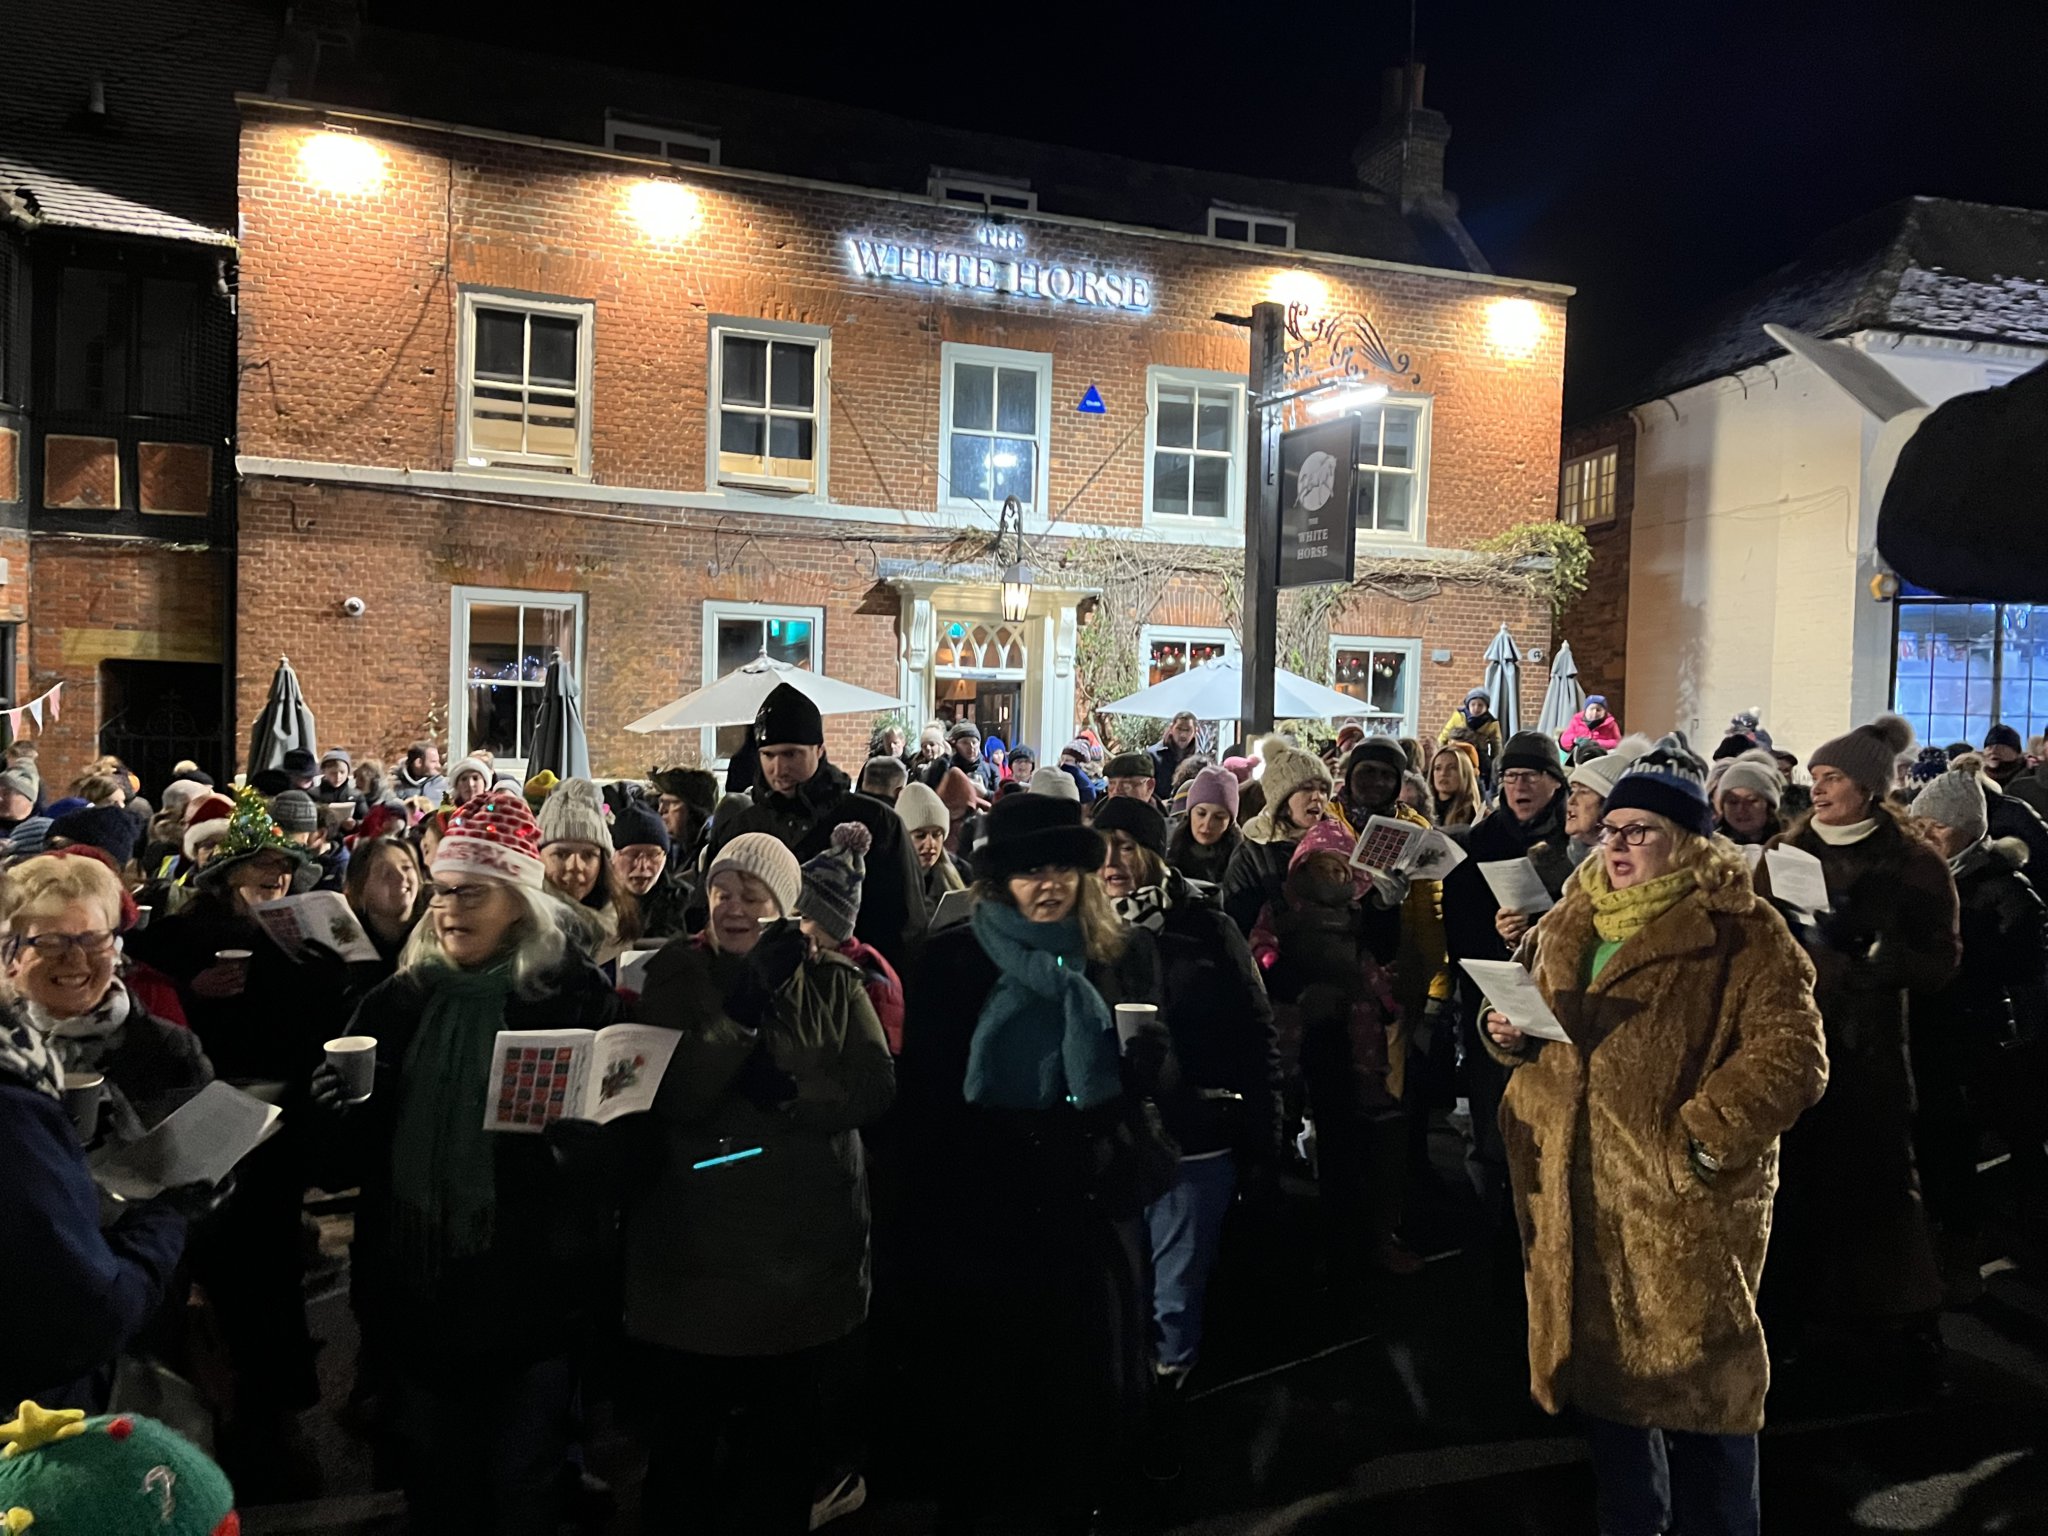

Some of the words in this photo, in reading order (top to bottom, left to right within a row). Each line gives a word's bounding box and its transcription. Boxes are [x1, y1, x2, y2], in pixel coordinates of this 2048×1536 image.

[977, 225, 1024, 250] THE
[848, 236, 1000, 291] WHITE
[1009, 260, 1151, 311] HORSE
[1297, 529, 1328, 542] WHITE
[1297, 545, 1328, 560] HORSE
